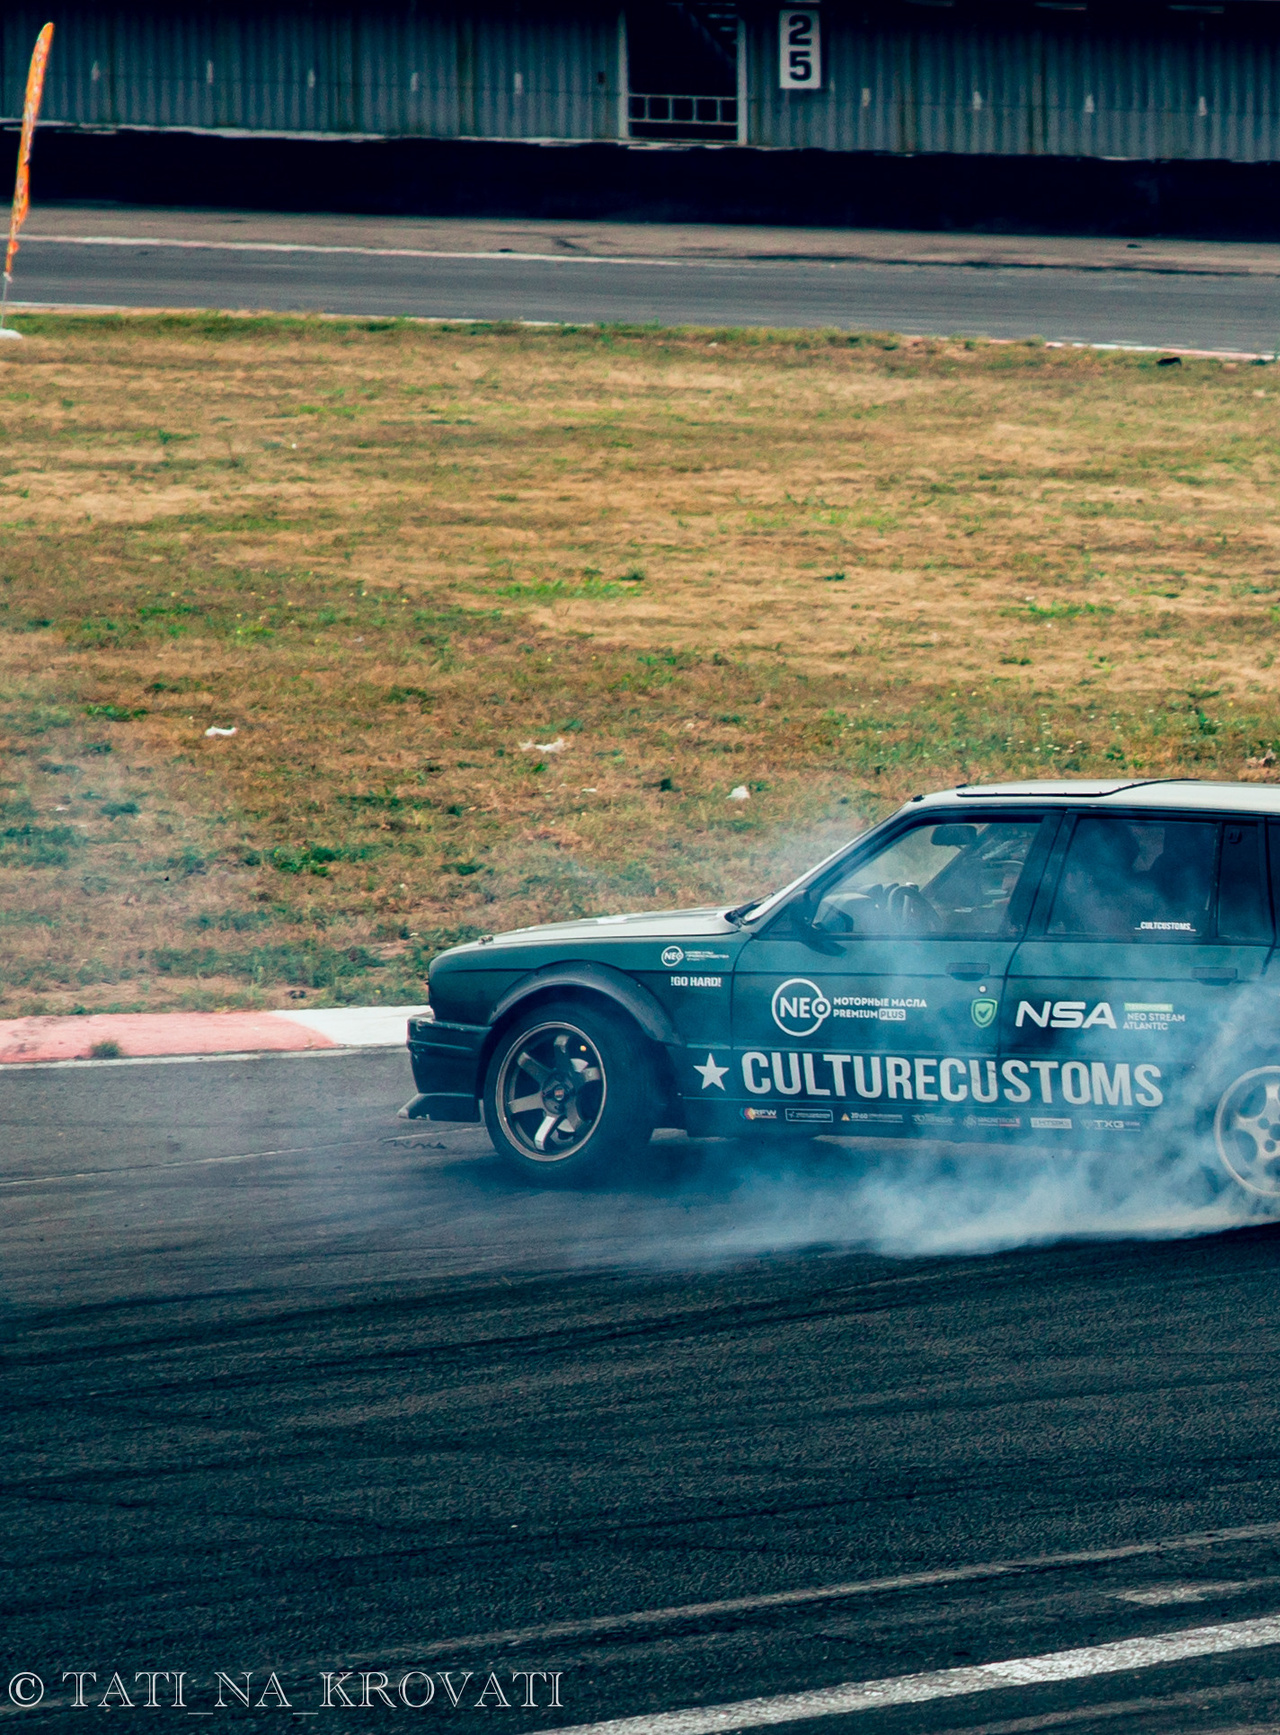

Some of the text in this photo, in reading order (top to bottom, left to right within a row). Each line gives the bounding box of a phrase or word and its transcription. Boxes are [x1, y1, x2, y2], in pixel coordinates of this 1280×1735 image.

[788, 13, 813, 82] 25
[664, 951, 684, 961] NEO
[690, 976, 722, 987] HARD!
[779, 997, 831, 1019] NEO
[833, 997, 927, 1008] МОТОРНЫЕ МАСЛА
[833, 1010, 904, 1020] PREMIUM PLUS
[1015, 1001, 1117, 1029] NSA
[1127, 1012, 1186, 1022] NEO STREAM
[1123, 1022, 1169, 1031] ATLANTIC
[741, 1051, 1164, 1108] CULTURECUSTOMS
